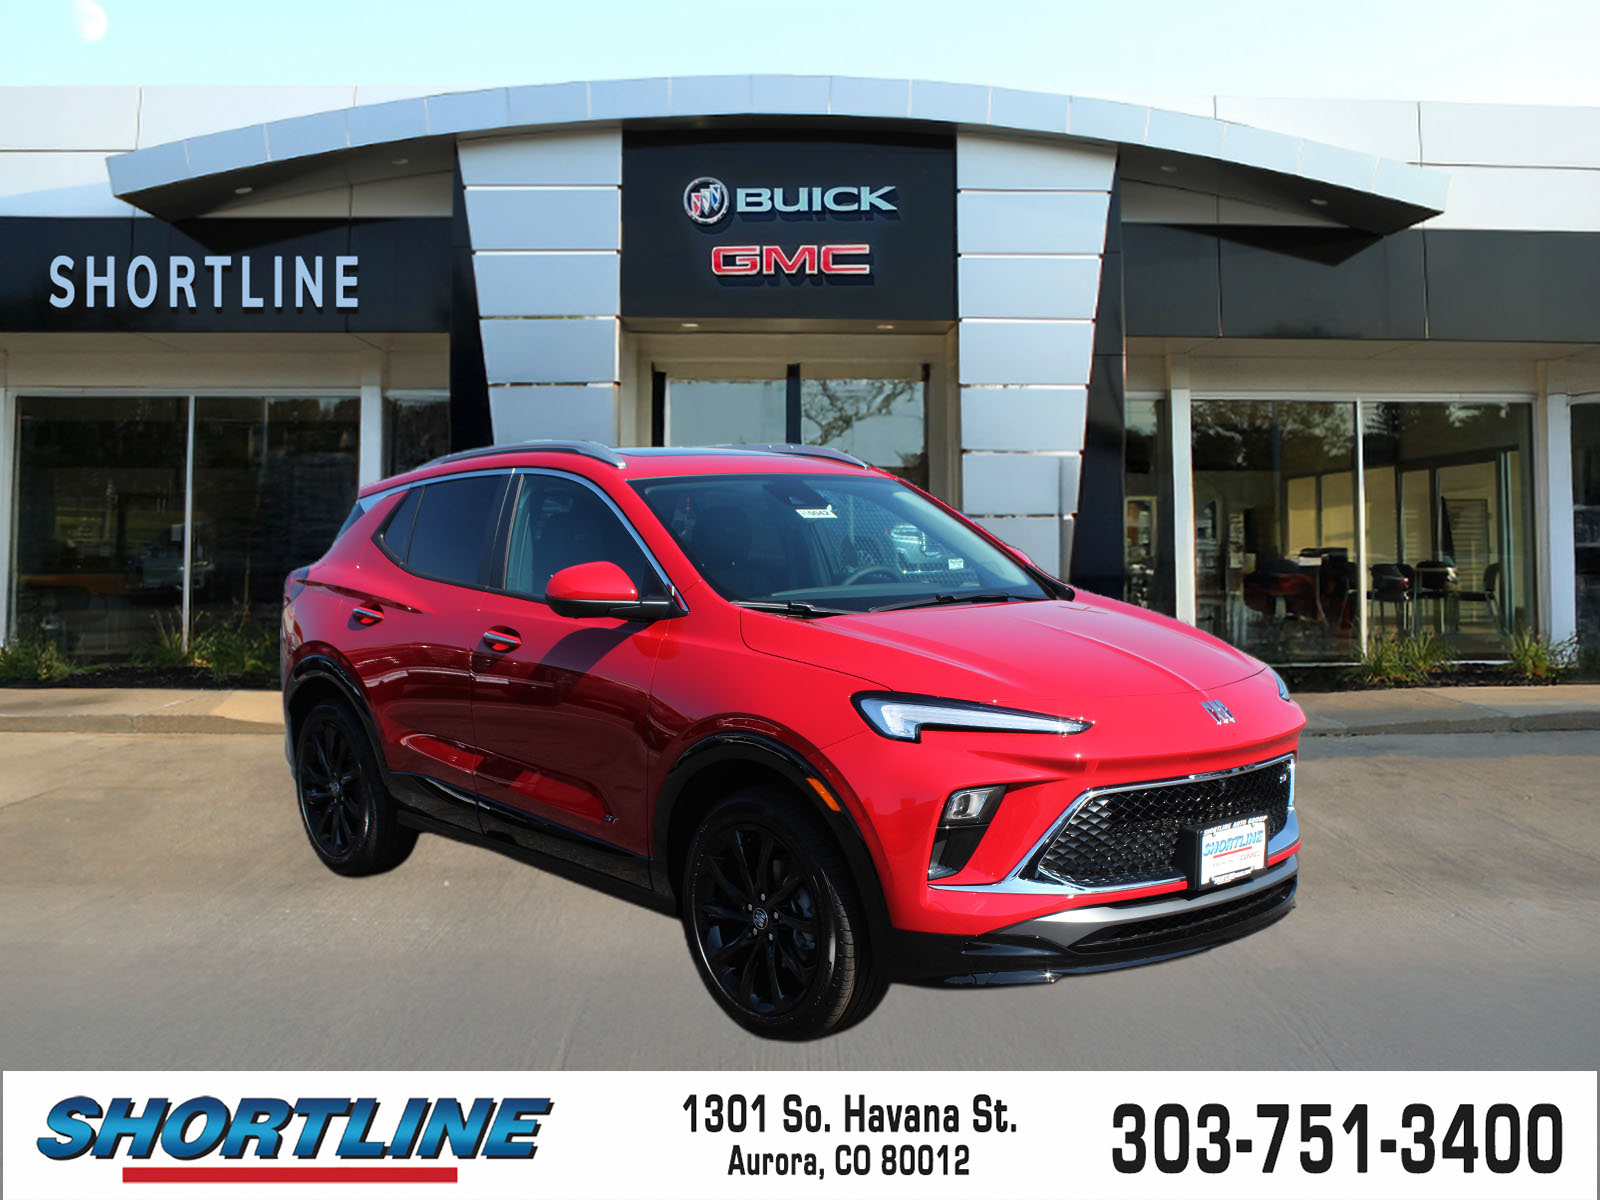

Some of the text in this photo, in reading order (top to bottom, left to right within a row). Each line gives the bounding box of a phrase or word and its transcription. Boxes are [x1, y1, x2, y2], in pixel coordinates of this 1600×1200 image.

[736, 186, 898, 213] BUICK
[711, 244, 871, 276] GMC
[49, 255, 360, 309] SHORTLINE
[1203, 830, 1264, 856] SHORTLINE
